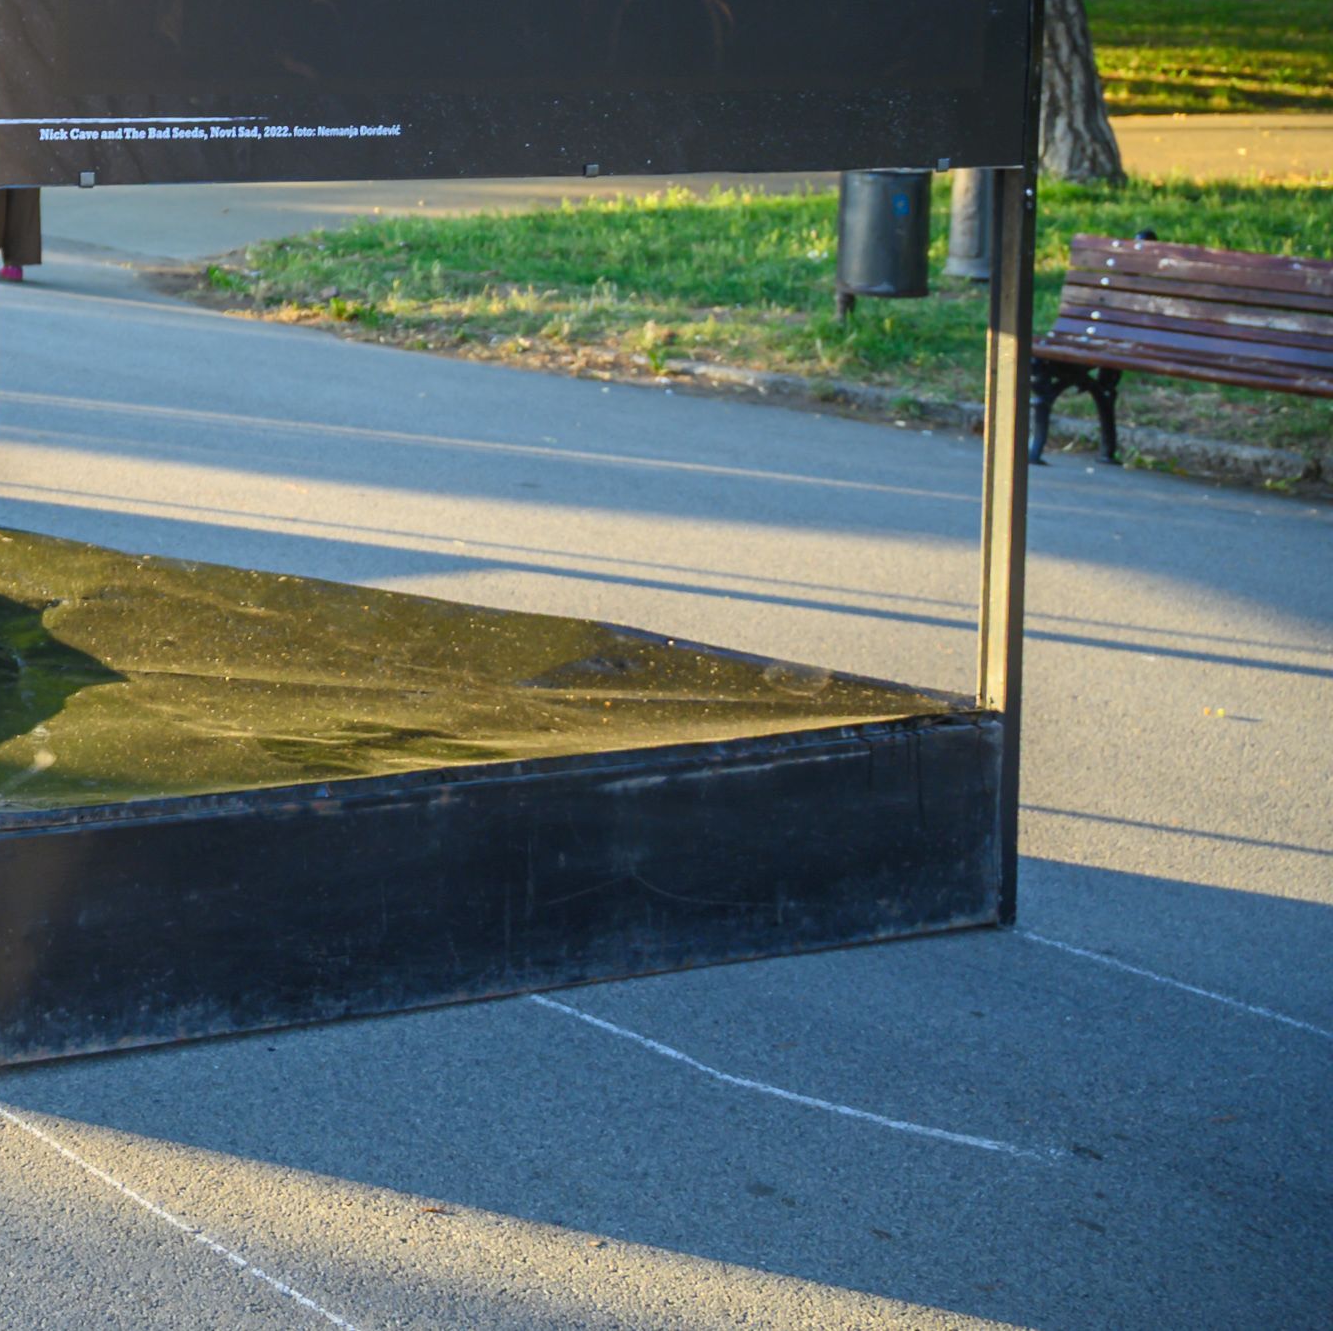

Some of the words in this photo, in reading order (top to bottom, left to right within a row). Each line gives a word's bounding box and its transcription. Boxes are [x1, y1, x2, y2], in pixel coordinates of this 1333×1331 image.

[39, 128, 68, 140] Nick
[69, 128, 99, 140] Cave
[100, 127, 123, 140] and
[123, 127, 147, 139] The
[147, 126, 171, 139] Bad
[172, 126, 208, 140] Seeds,
[209, 125, 237, 138] Novi
[237, 125, 262, 139] Sad,
[263, 125, 292, 137] 2022.
[293, 125, 316, 137] foto:
[317, 125, 359, 138] Nemanja
